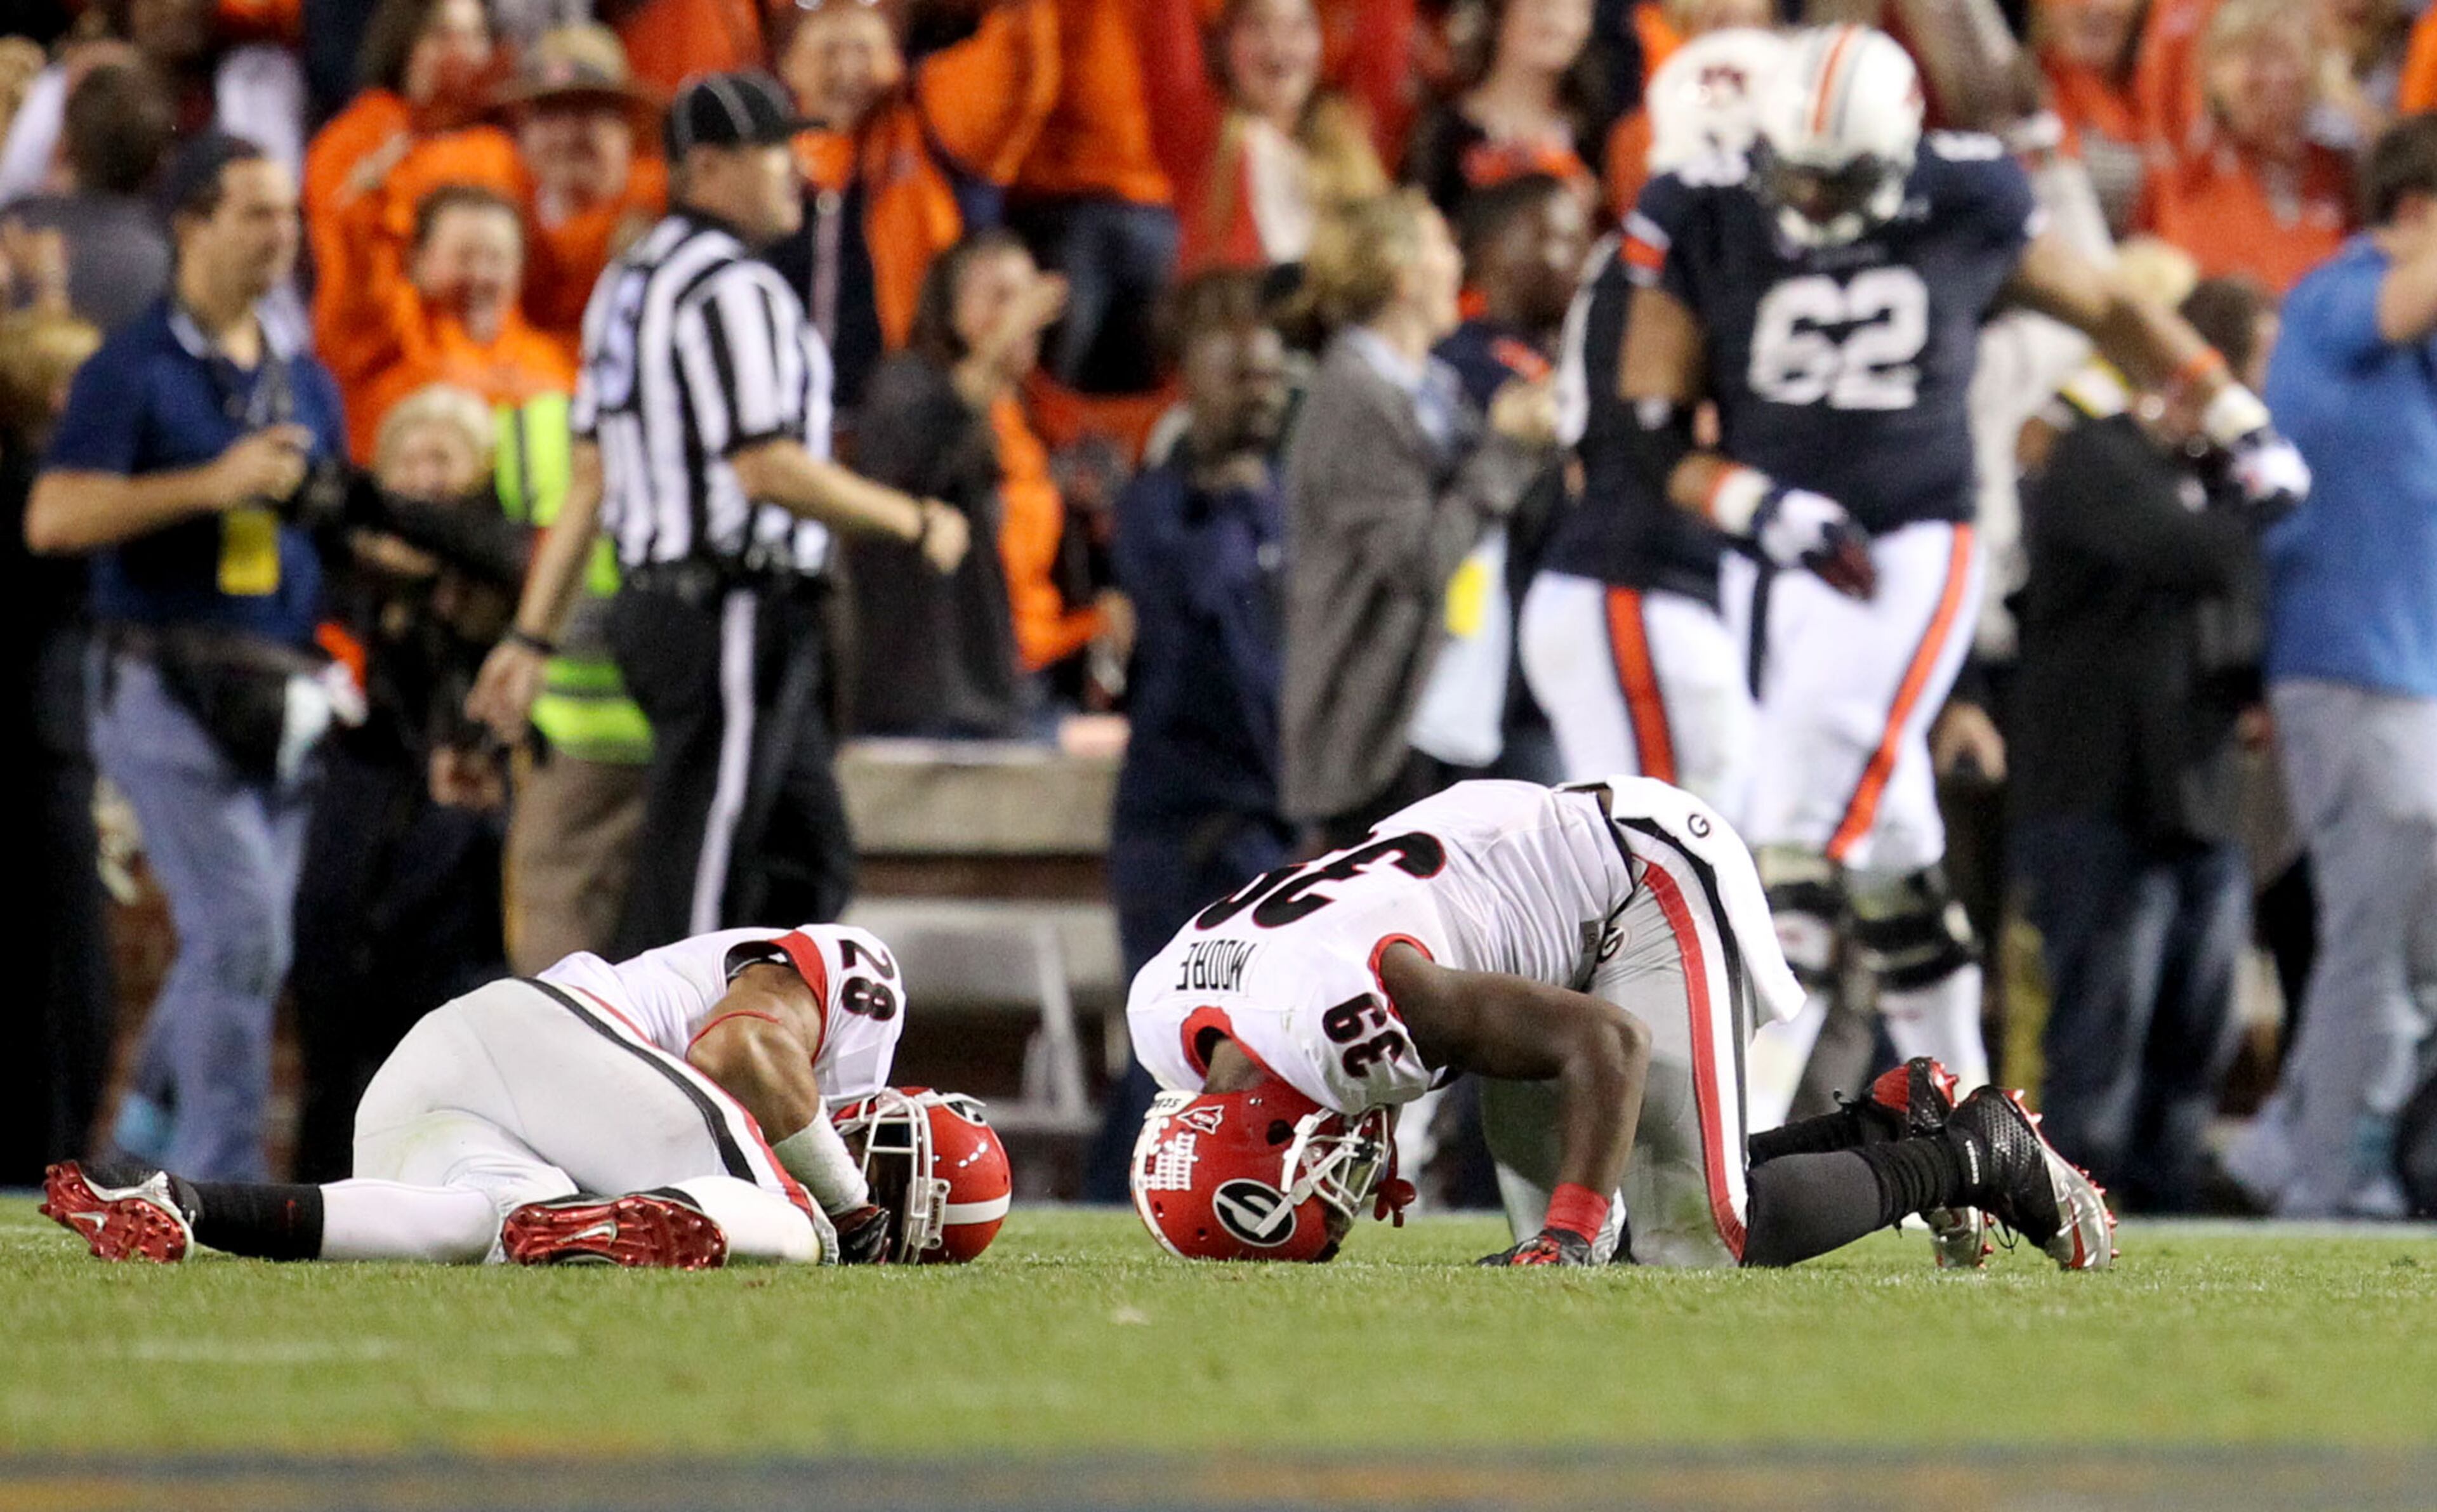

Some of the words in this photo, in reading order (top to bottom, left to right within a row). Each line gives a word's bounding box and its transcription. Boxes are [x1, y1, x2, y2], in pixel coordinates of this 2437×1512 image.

[1747, 265, 1929, 411] 62
[1688, 813, 1710, 838] G
[838, 938, 897, 1022] 28
[1175, 939, 1257, 992] MOORE
[1322, 992, 1405, 1077] 39
